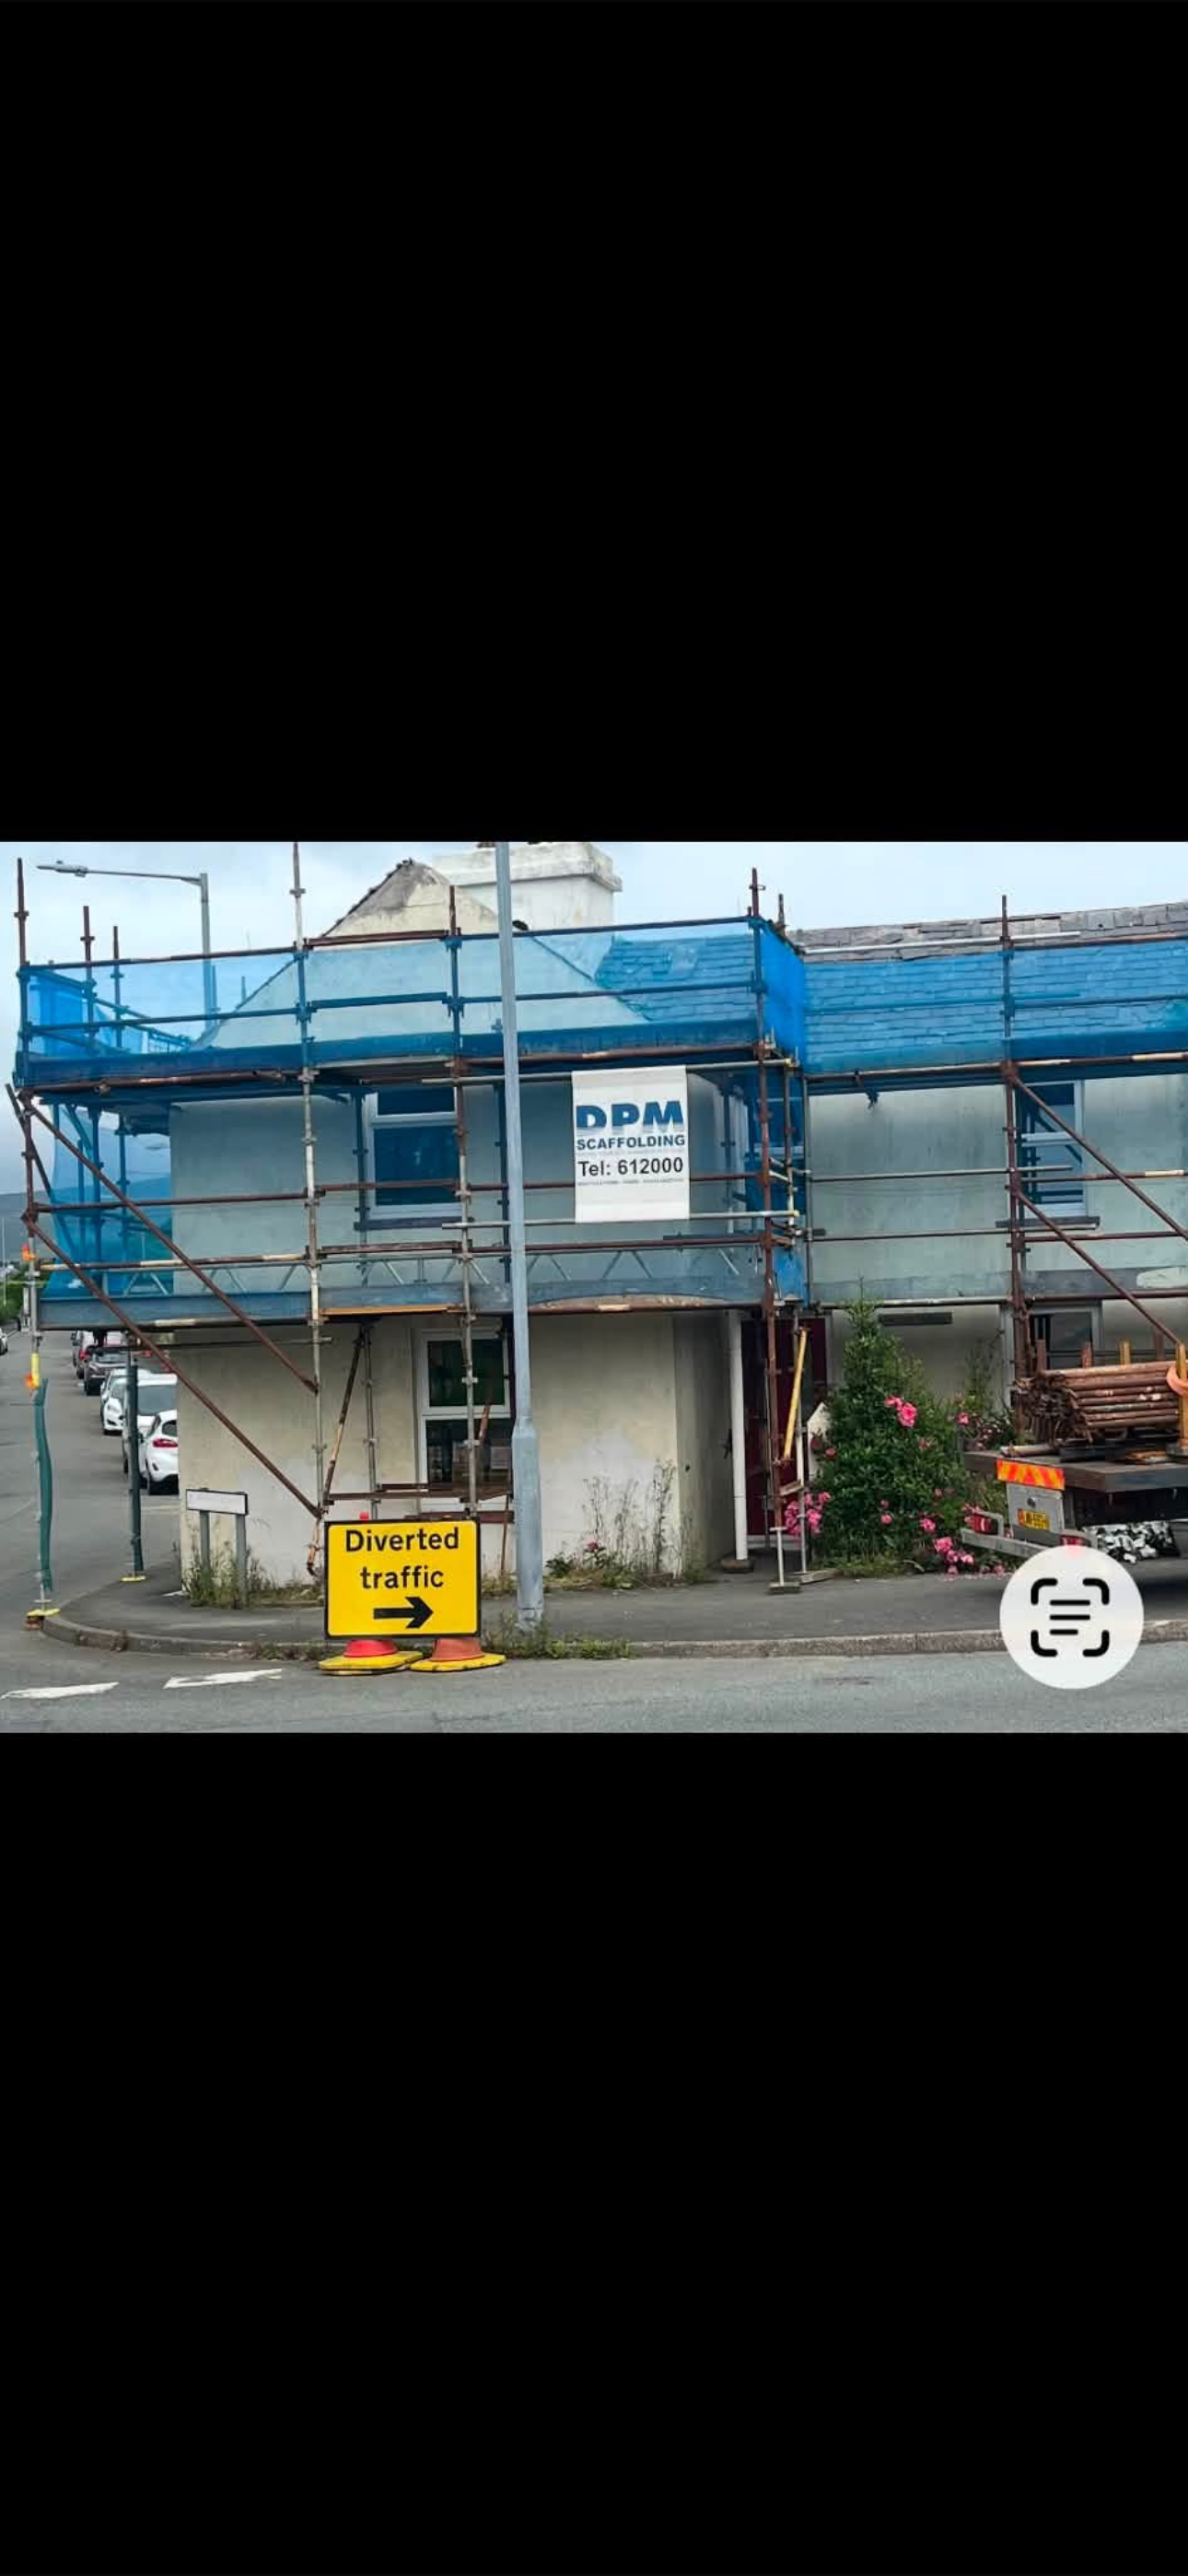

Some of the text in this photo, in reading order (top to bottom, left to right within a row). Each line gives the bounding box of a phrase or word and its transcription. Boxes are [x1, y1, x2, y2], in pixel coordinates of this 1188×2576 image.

[576, 1100, 683, 1128] DPM
[577, 1134, 685, 1151] SCAFFOLDING
[577, 1157, 683, 1177] Tel: 612000
[345, 1526, 459, 1552] Diverted
[360, 1564, 444, 1589] traffic
